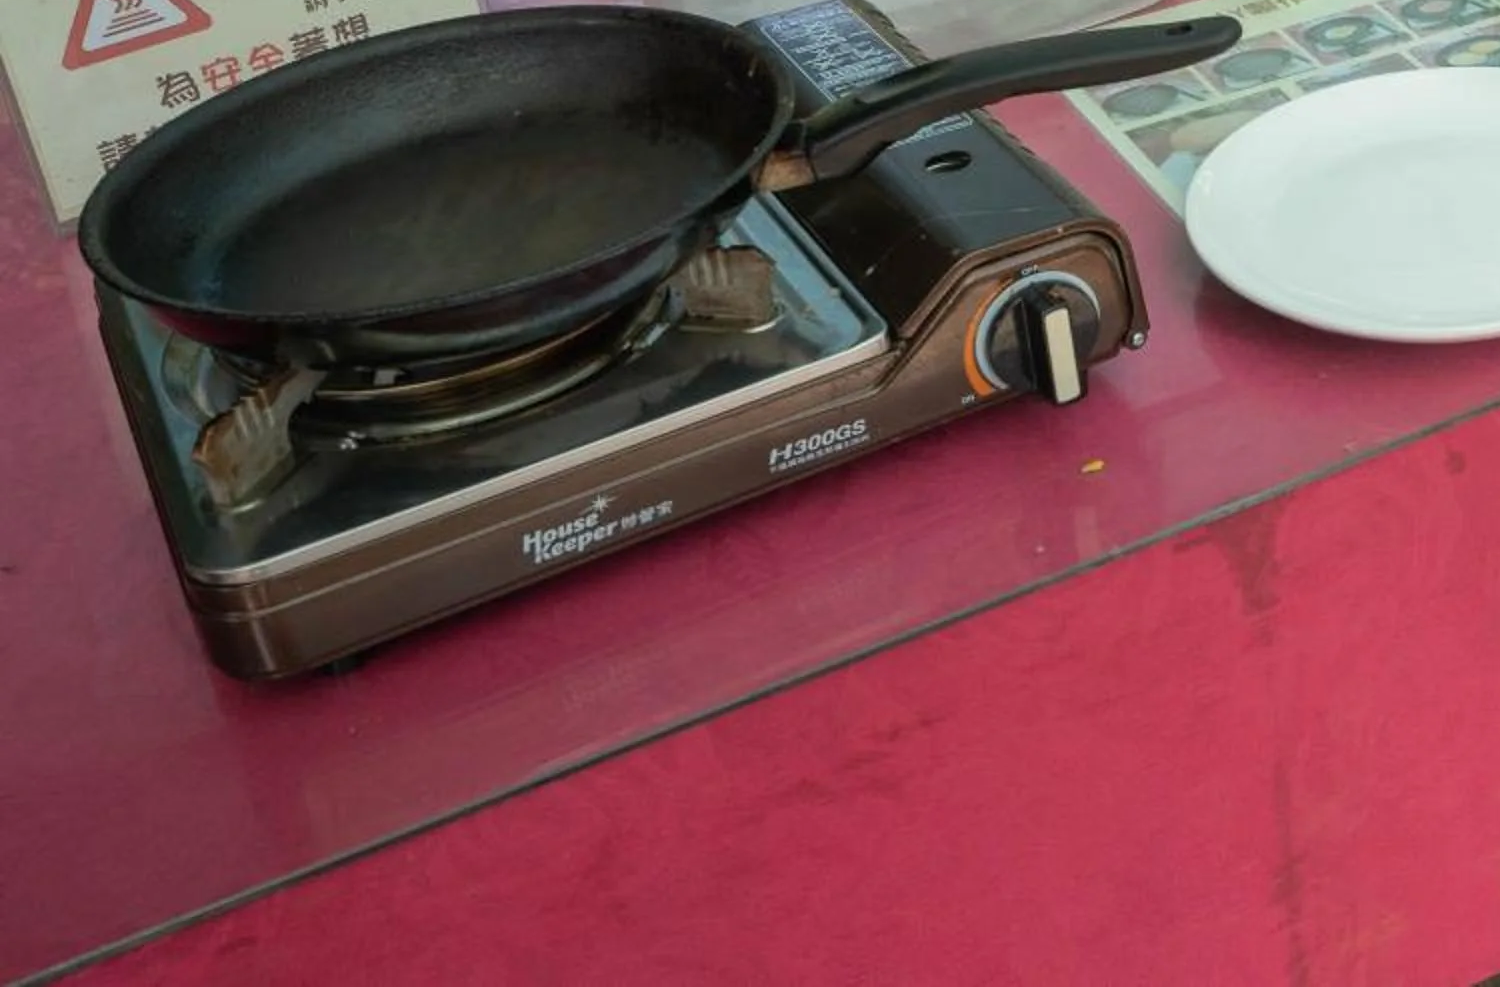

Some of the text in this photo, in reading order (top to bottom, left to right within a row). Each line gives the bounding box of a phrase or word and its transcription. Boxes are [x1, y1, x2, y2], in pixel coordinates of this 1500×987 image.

[768, 418, 867, 467] H300GS
[522, 512, 600, 554] House
[533, 520, 619, 564] Keeper
